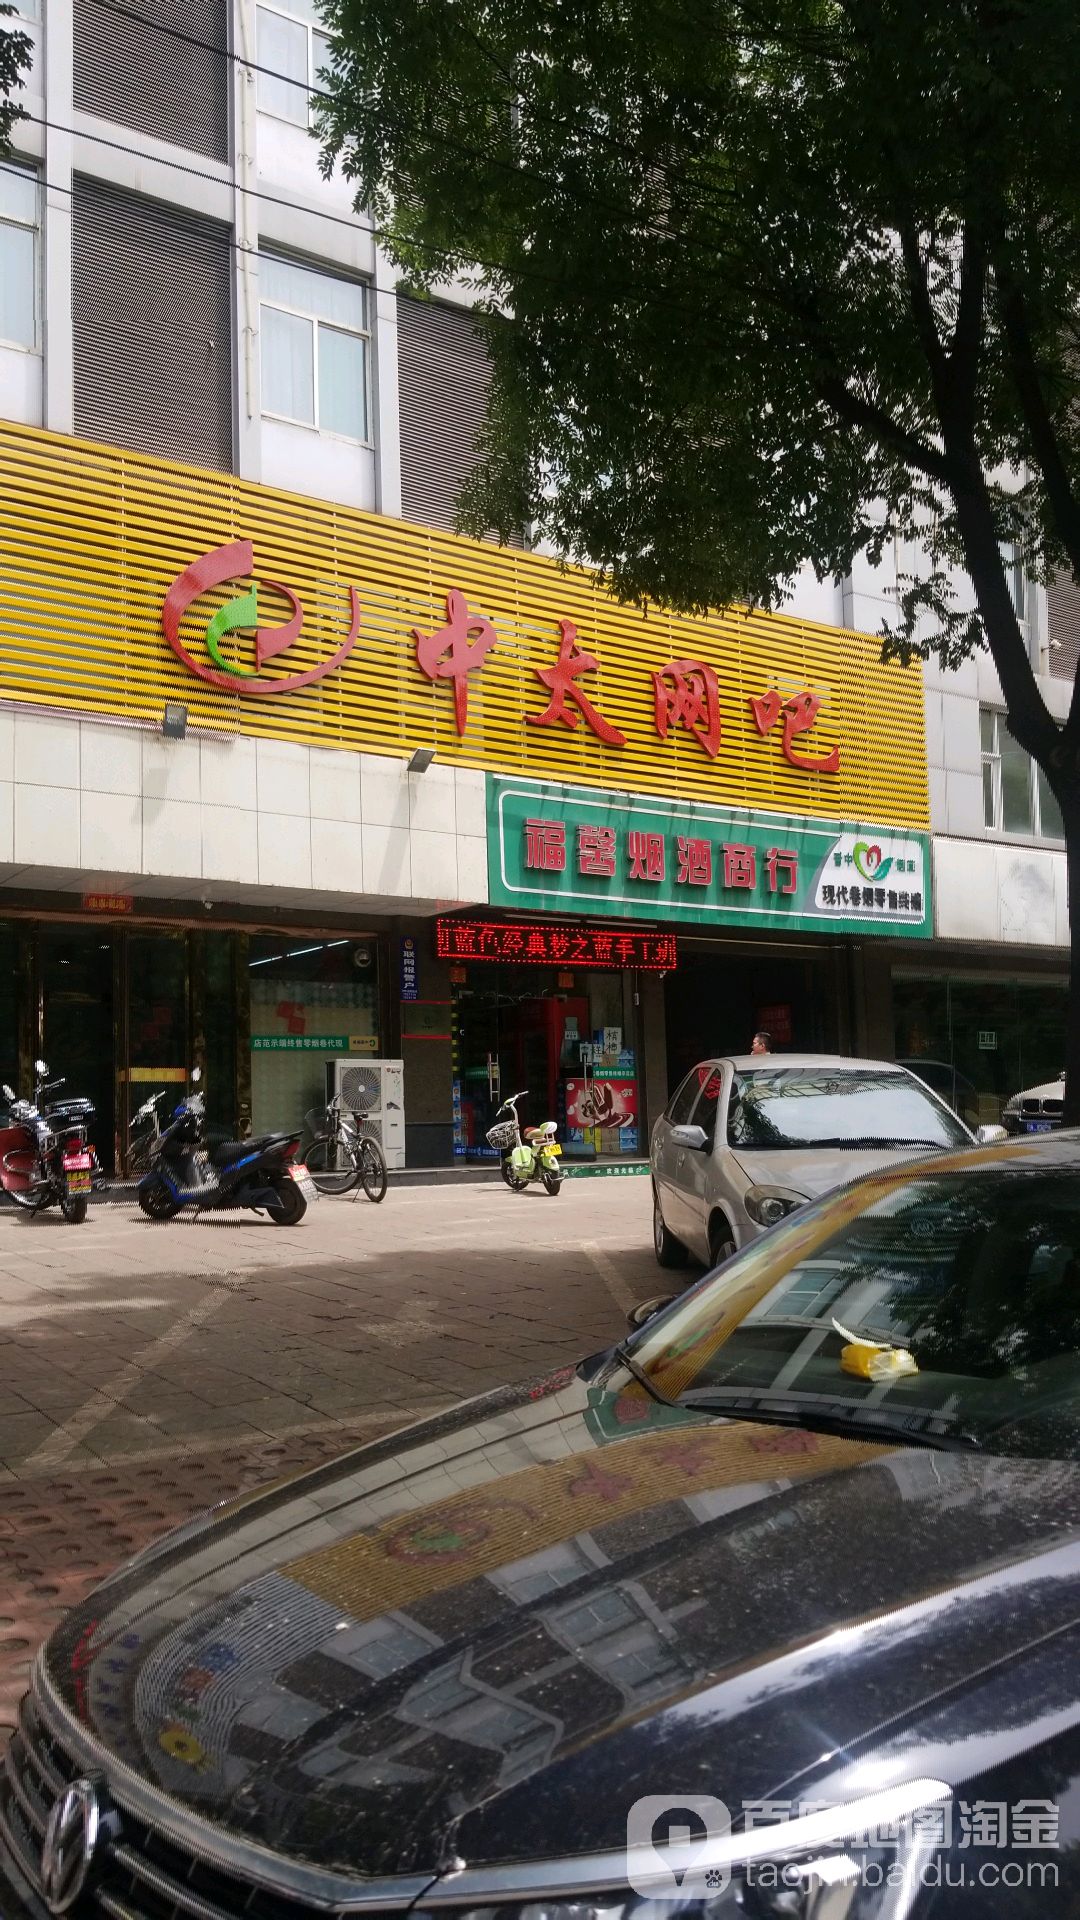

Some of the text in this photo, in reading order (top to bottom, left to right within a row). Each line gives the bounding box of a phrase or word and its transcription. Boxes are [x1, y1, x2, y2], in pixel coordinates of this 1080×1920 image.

[412, 588, 840, 772] 中太网吧
[523, 817, 799, 894] 福馨烟酒商行
